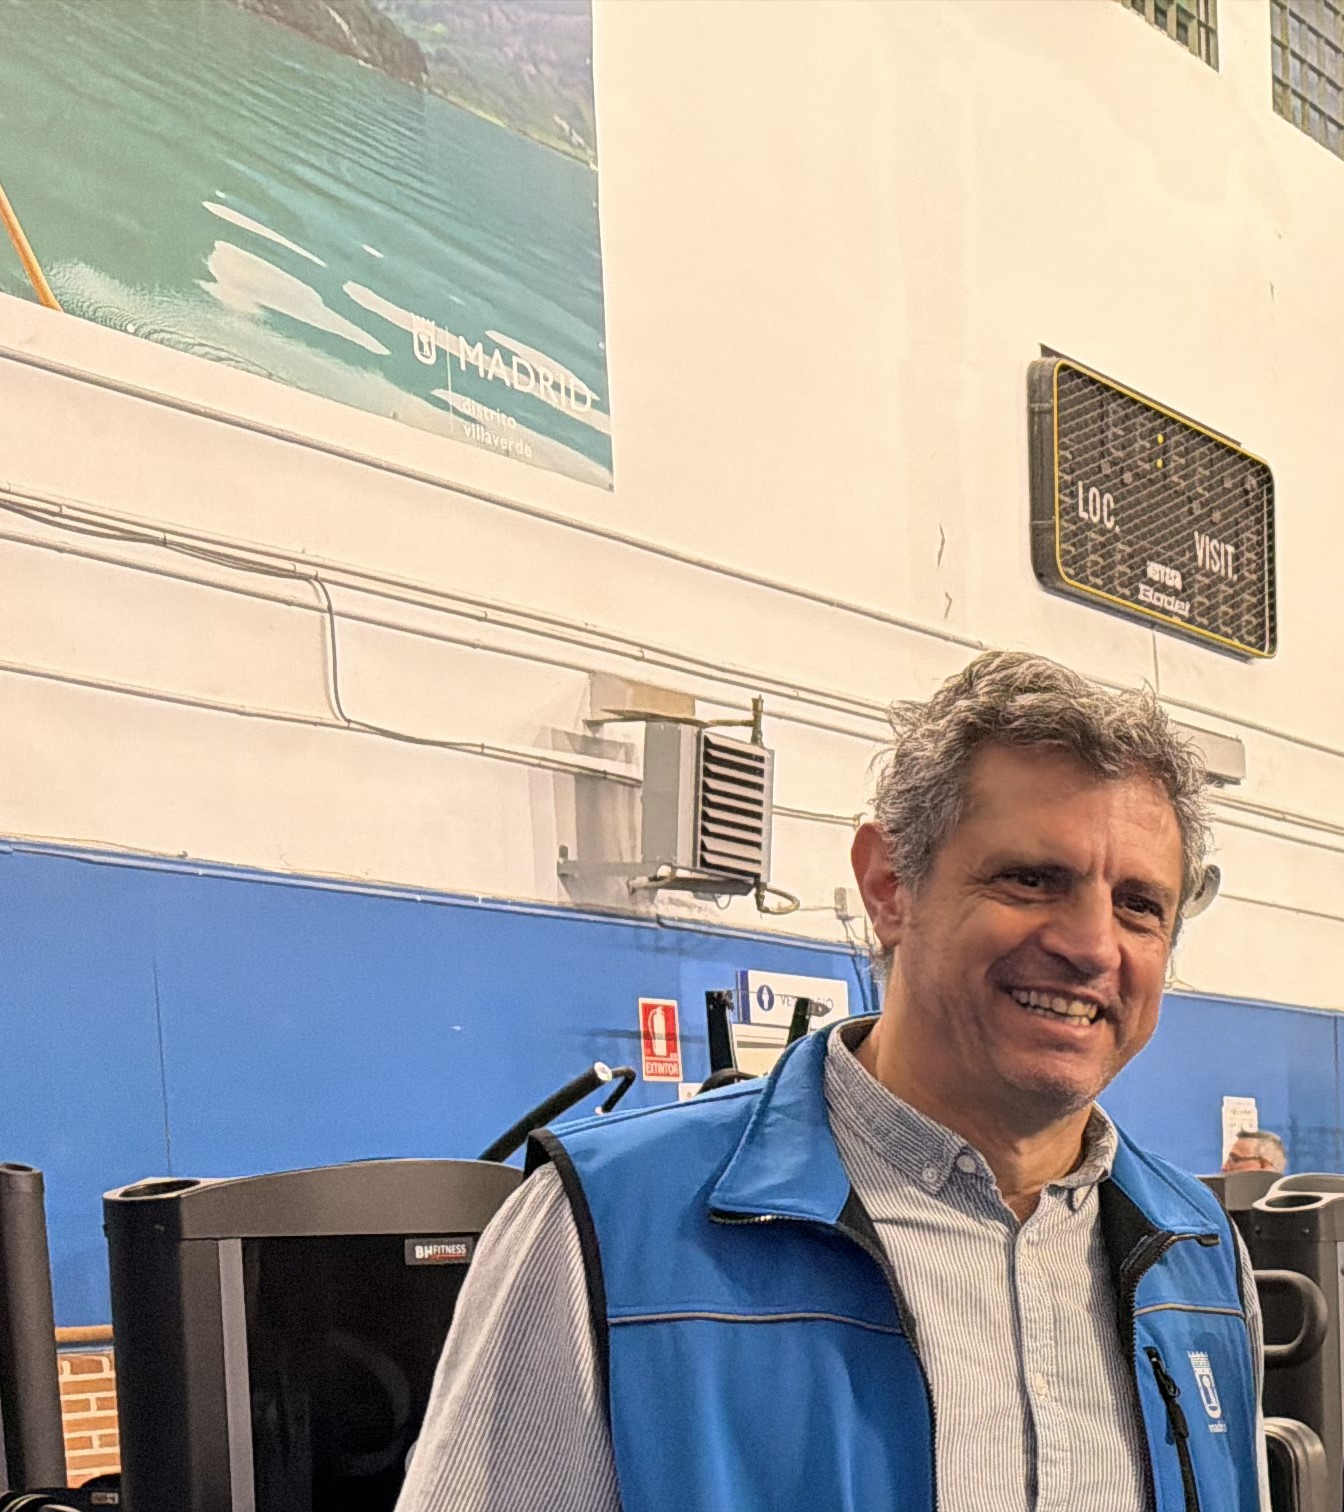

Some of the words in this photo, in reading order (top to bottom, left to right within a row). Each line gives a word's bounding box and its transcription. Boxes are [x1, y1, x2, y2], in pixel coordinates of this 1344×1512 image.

[458, 335, 591, 413] MADRID
[461, 400, 517, 430] distrito
[463, 423, 533, 458] villaverde
[1077, 480, 1120, 533] LOC.
[1194, 530, 1238, 581] VISIT.
[646, 1061, 679, 1076] EXTINTOR
